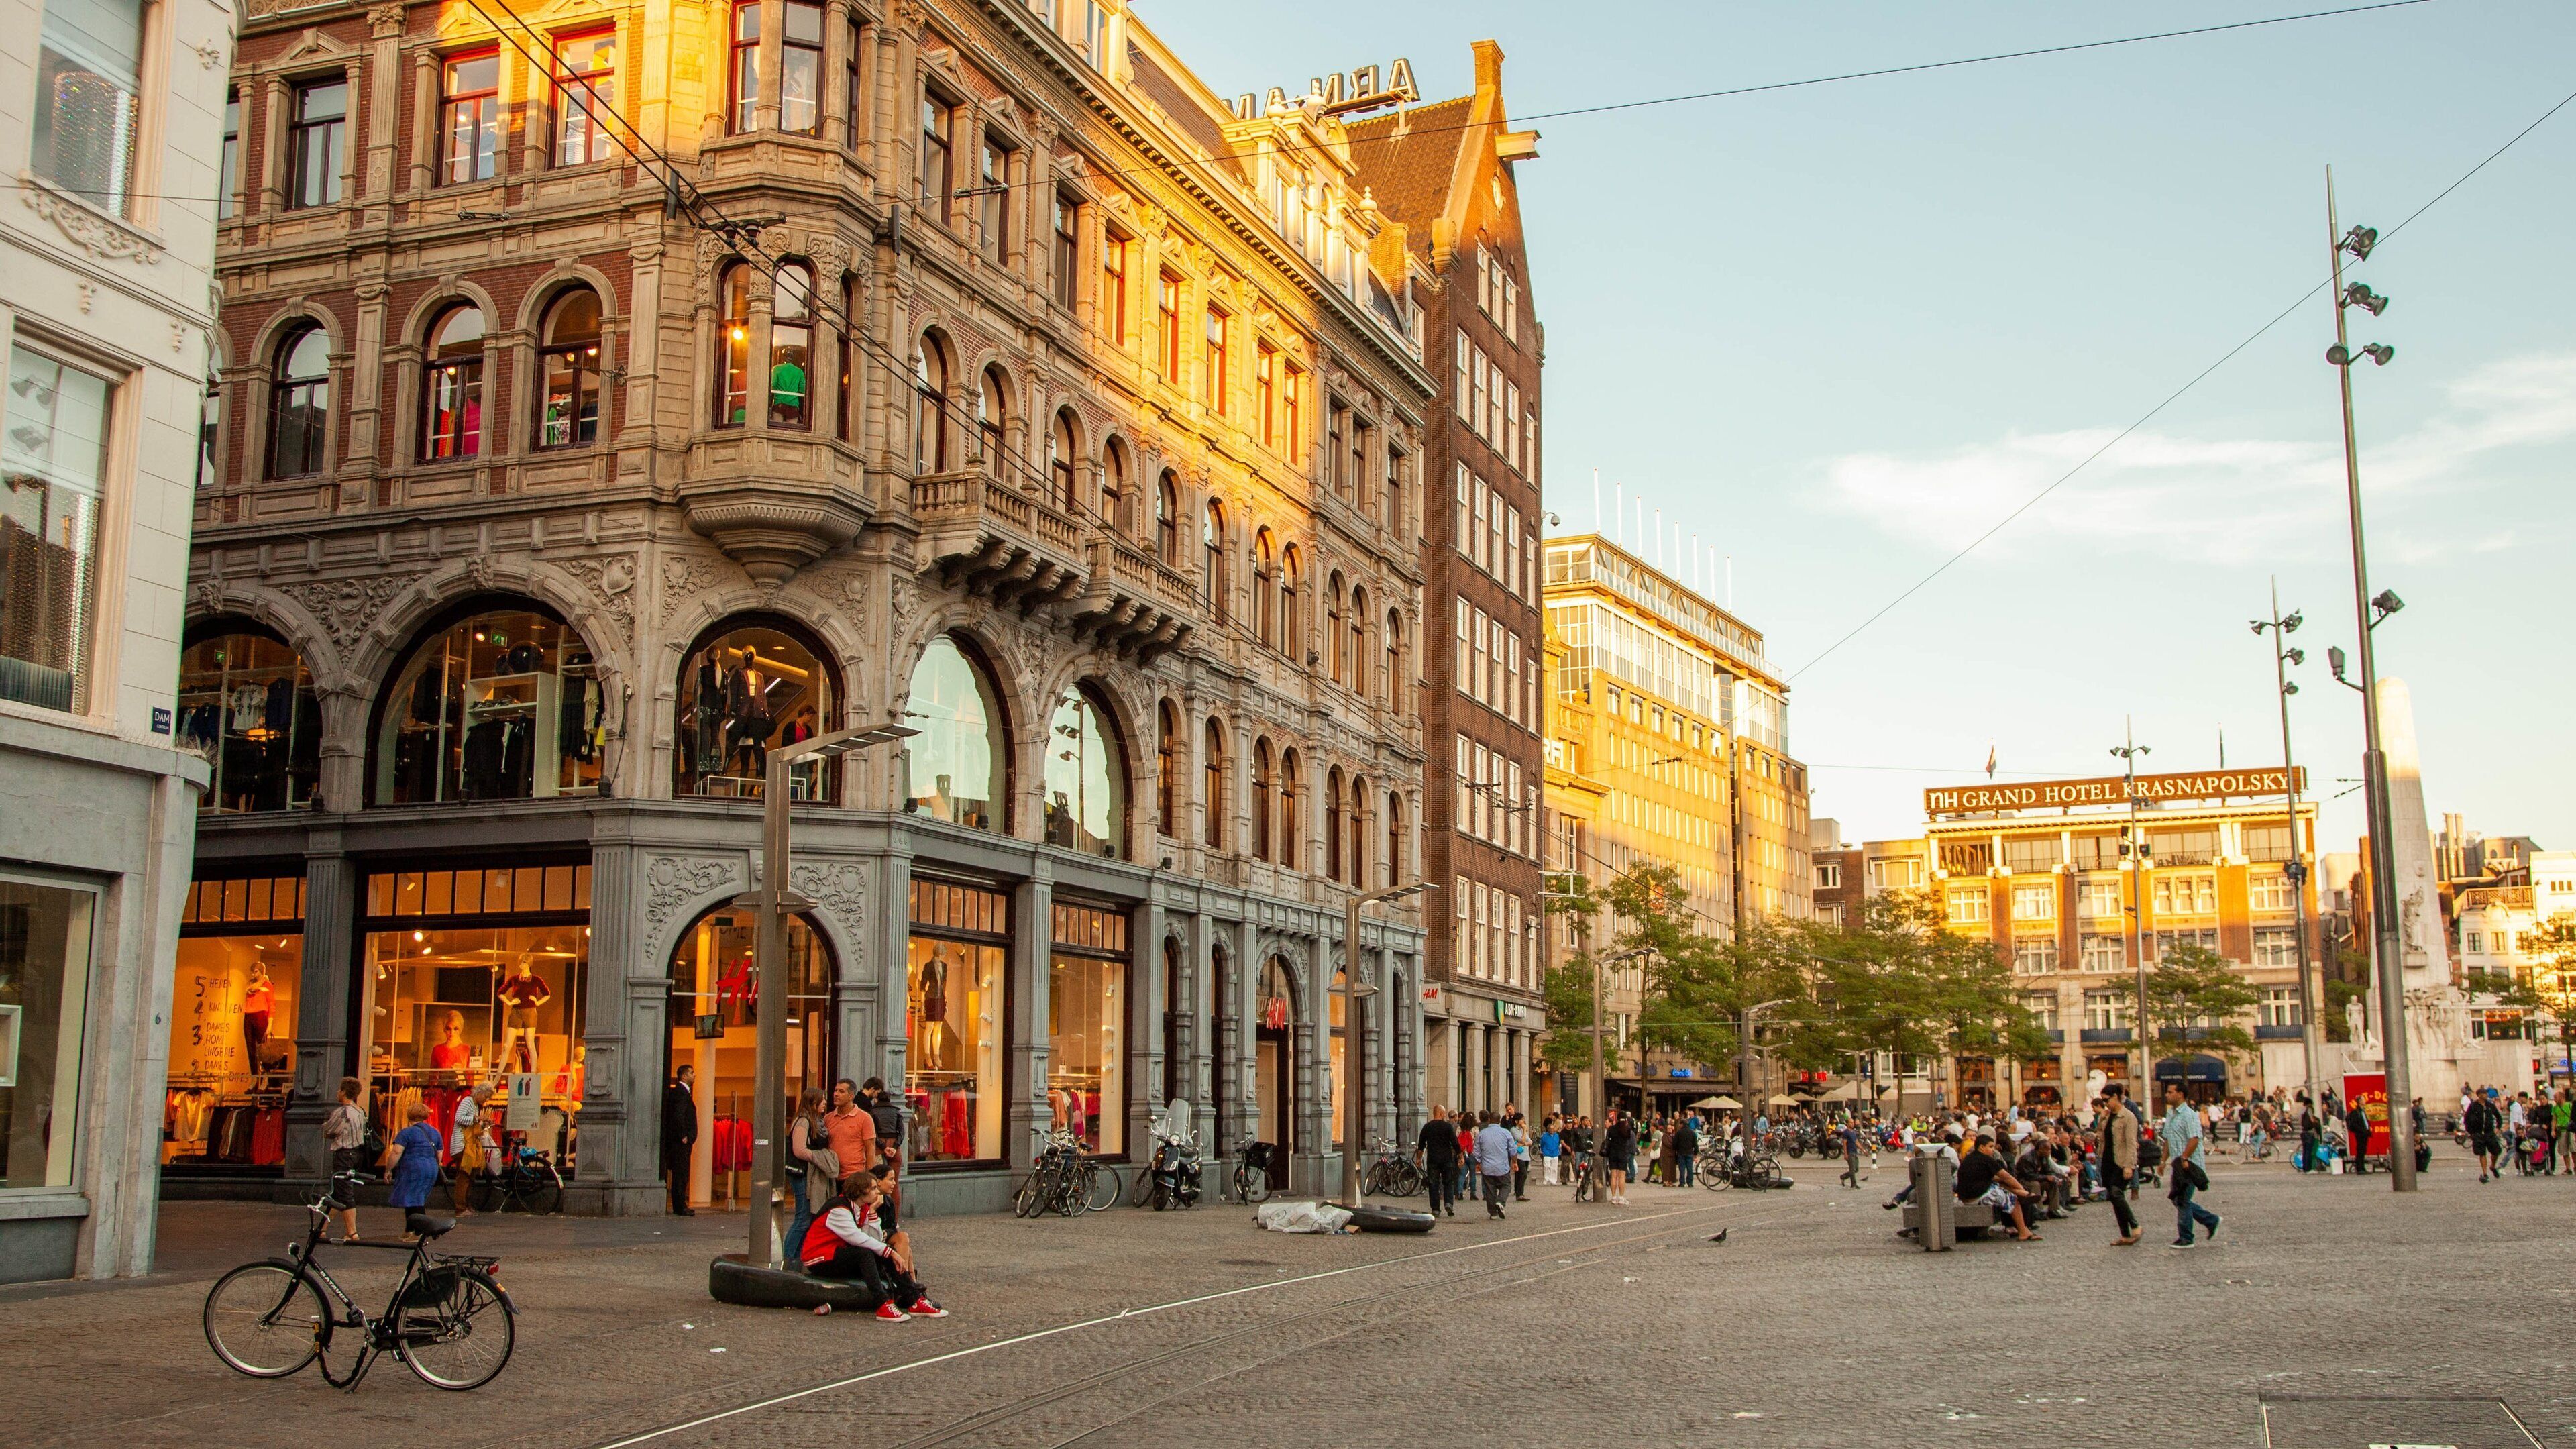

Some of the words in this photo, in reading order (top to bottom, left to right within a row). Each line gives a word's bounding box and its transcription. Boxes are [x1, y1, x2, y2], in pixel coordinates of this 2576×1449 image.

[155, 712, 170, 724] DAM
[1962, 788, 2036, 808] GRAND
[2045, 783, 2116, 803] HOTEL
[2123, 773, 2288, 798] KRASNAPOLSKY
[1422, 987, 1438, 1000] H&M
[209, 1001, 243, 1014] KINEN
[155, 1012, 162, 1025] 6
